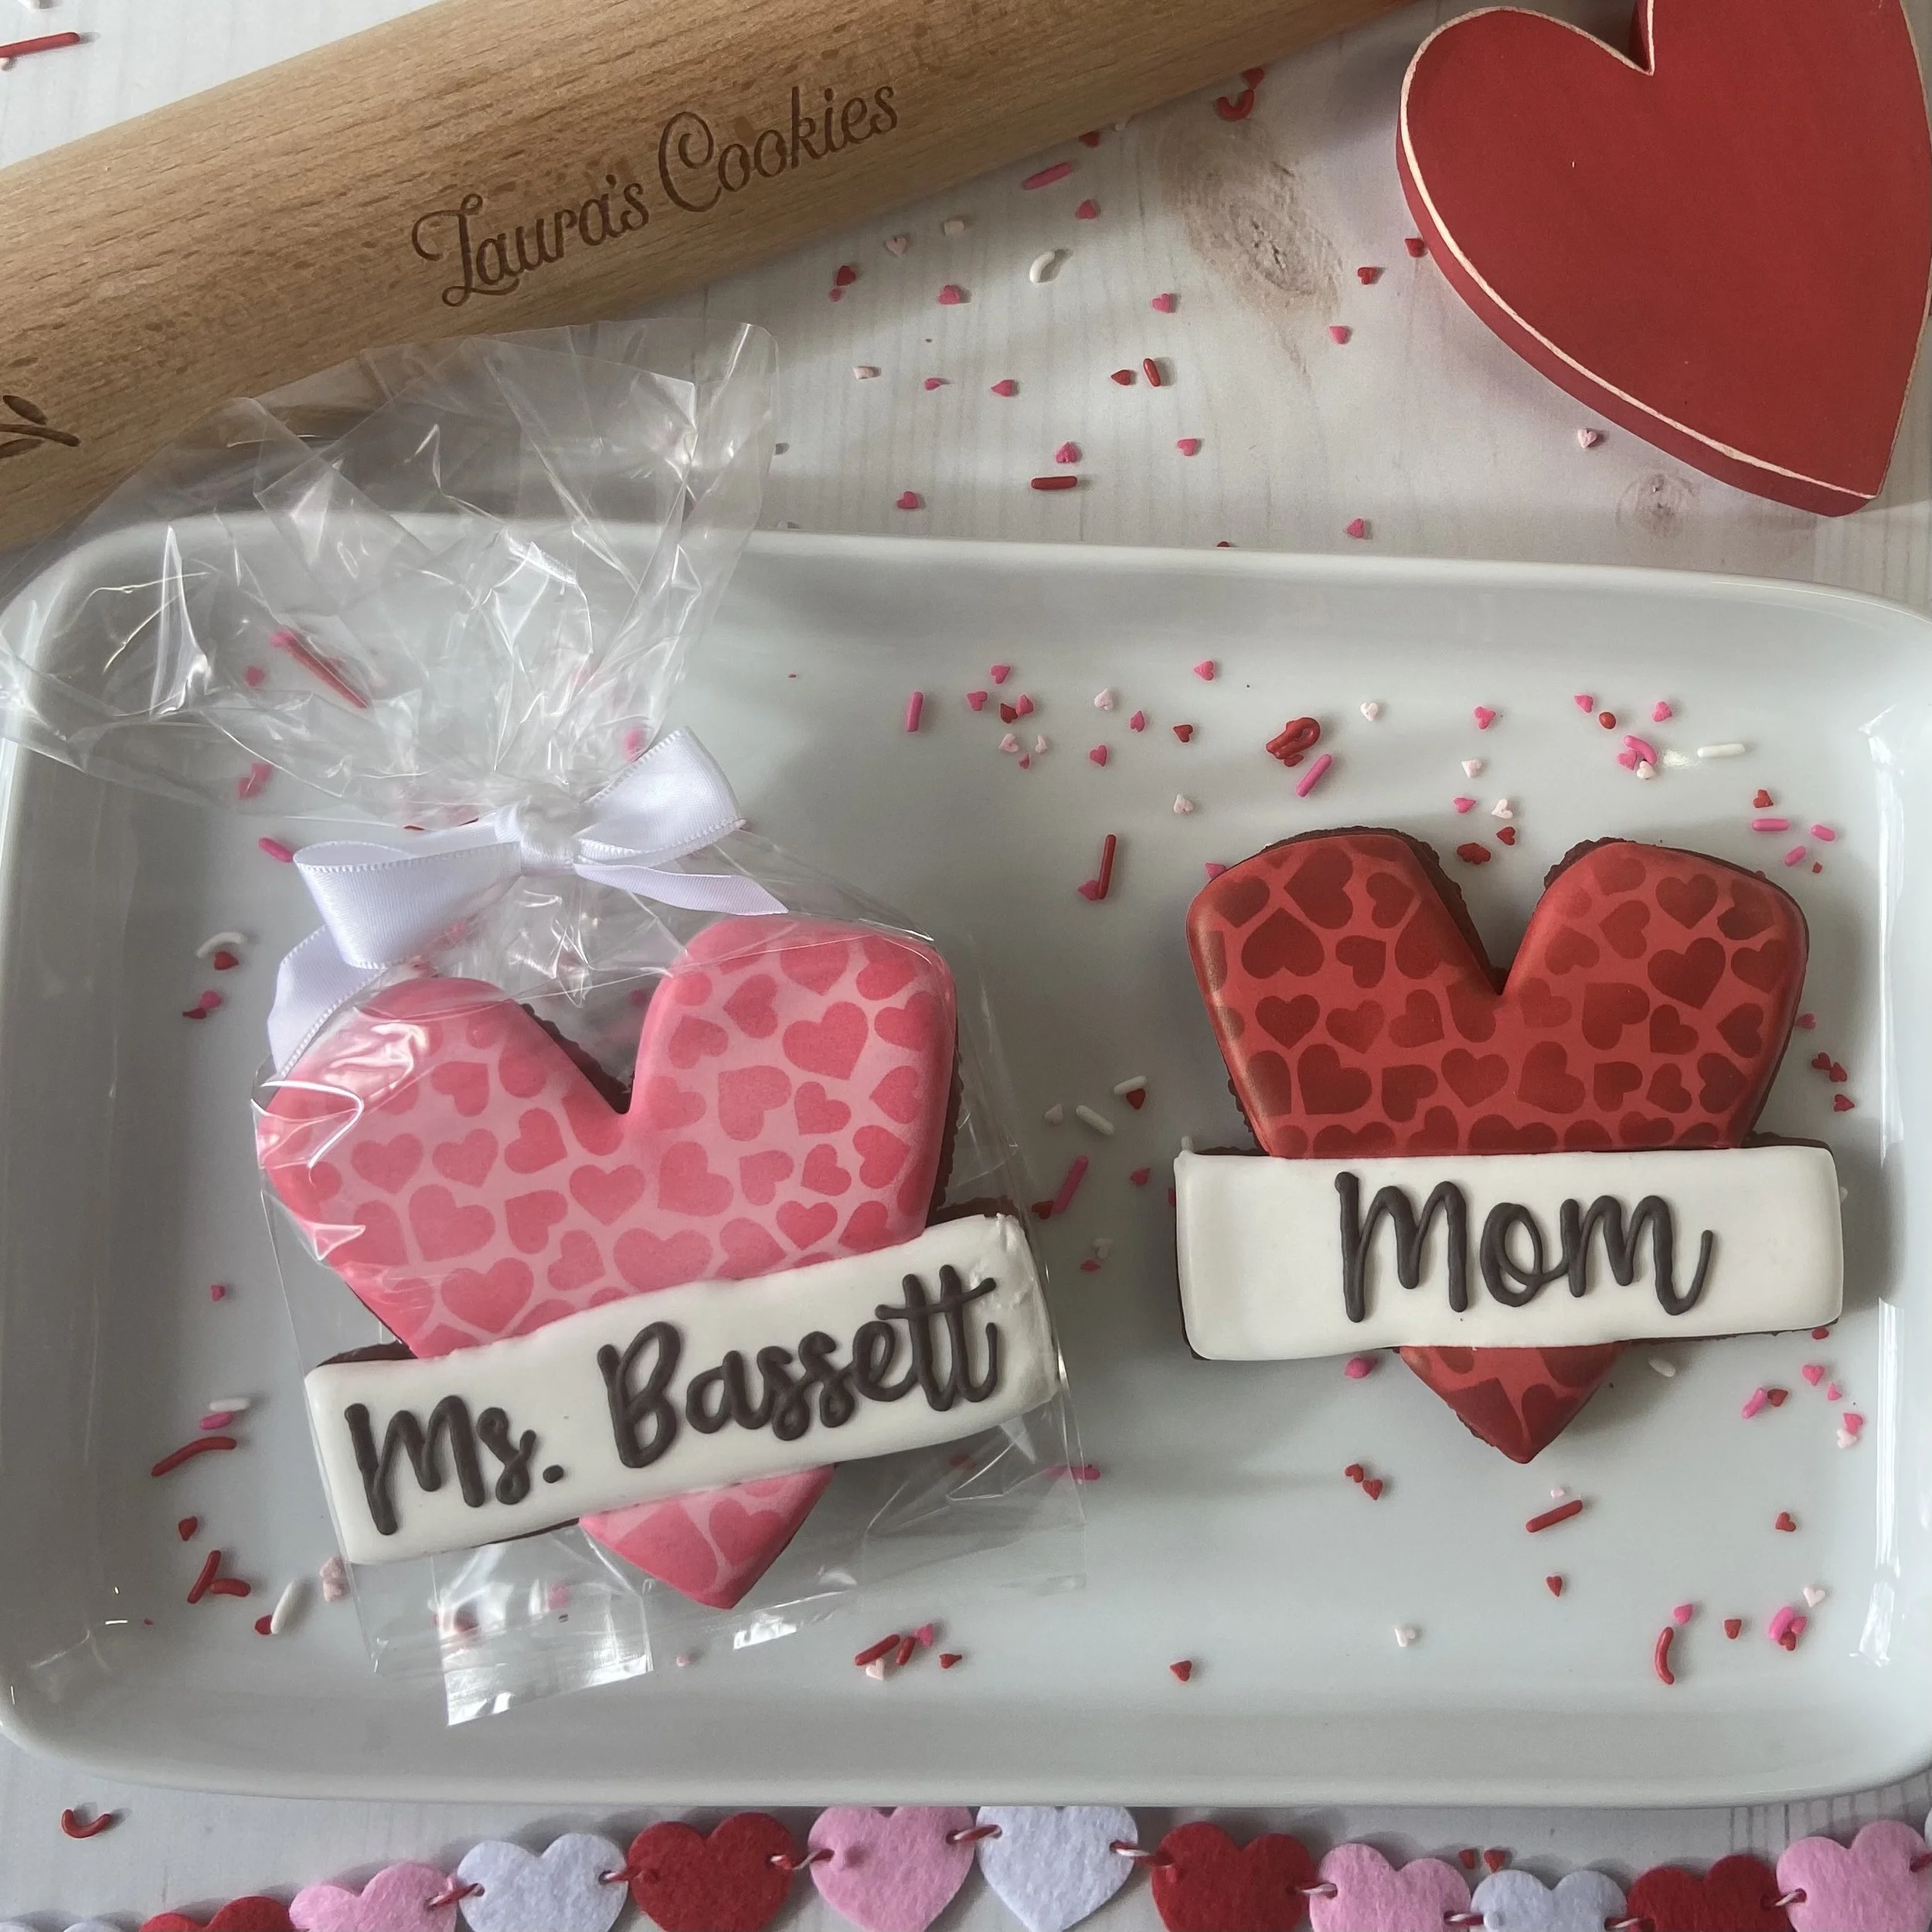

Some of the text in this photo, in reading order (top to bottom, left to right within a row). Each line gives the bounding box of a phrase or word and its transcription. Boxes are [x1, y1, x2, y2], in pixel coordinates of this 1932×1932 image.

[412, 86, 898, 307] Laura's Cookies
[1335, 1171, 1714, 1323] Mom
[345, 1264, 998, 1536] Ms. Bassett
